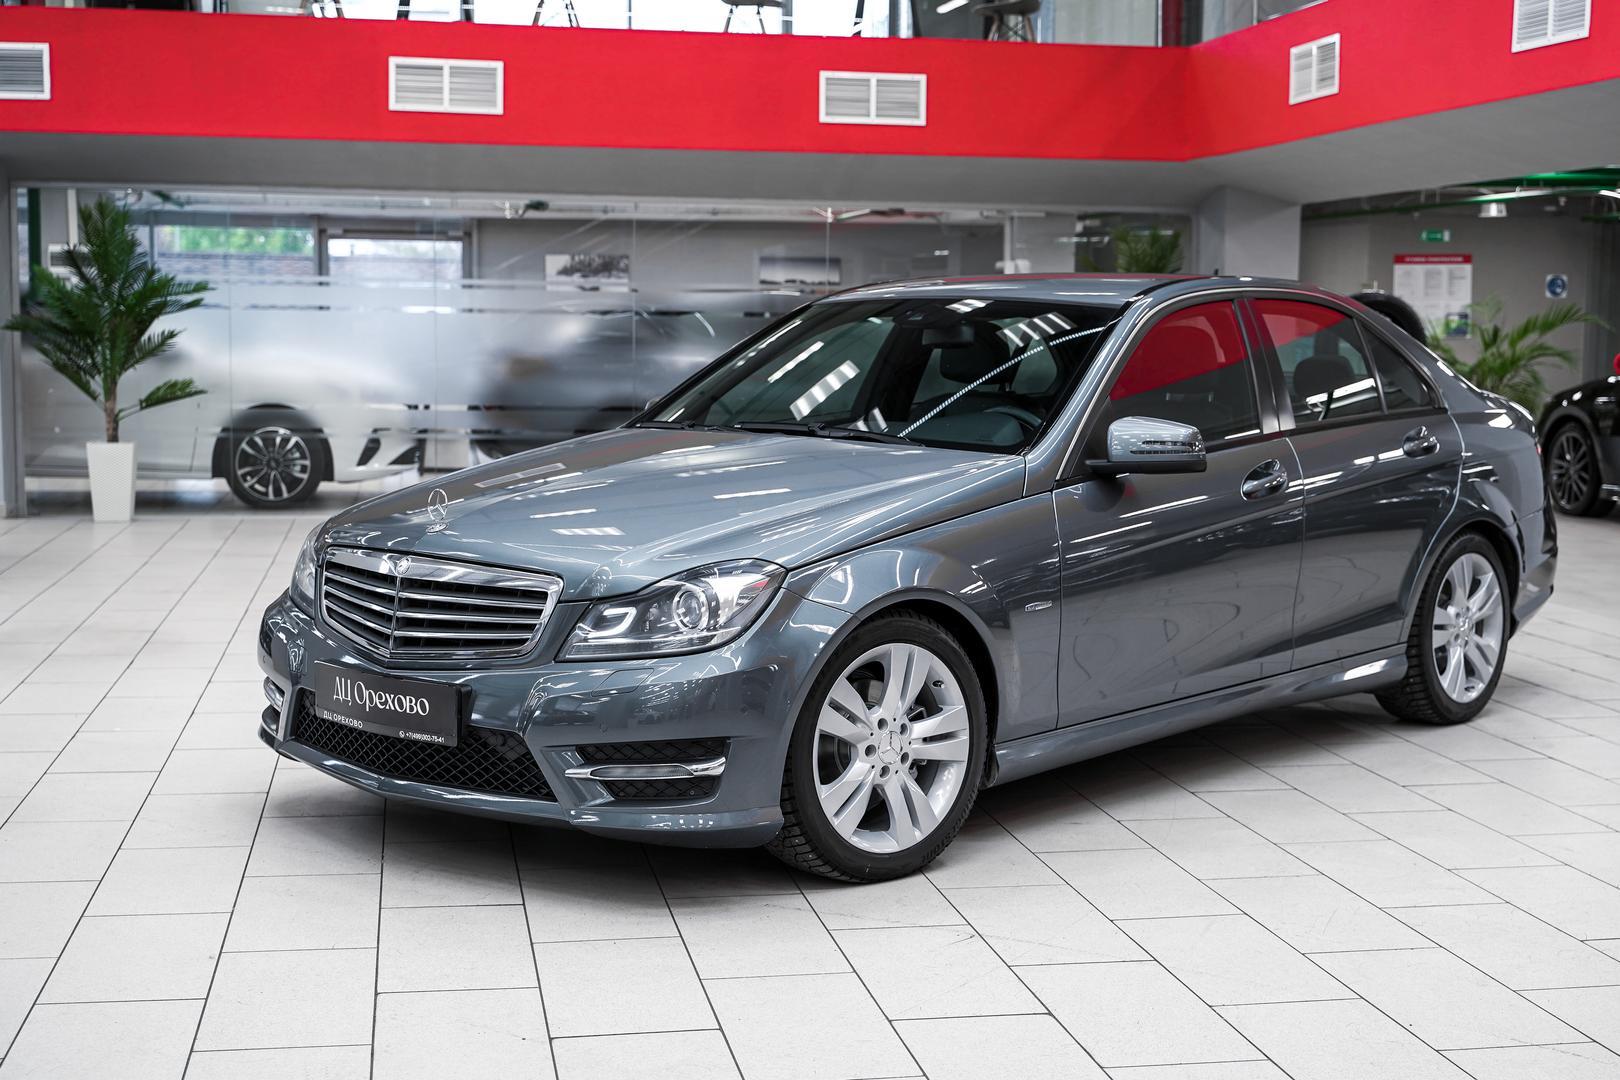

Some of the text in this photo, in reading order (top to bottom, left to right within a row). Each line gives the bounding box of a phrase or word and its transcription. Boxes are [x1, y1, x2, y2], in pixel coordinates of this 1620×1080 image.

[333, 676, 430, 716] ДЦ Орехово
[323, 711, 363, 728] ДЦ ОРЕХОВО
